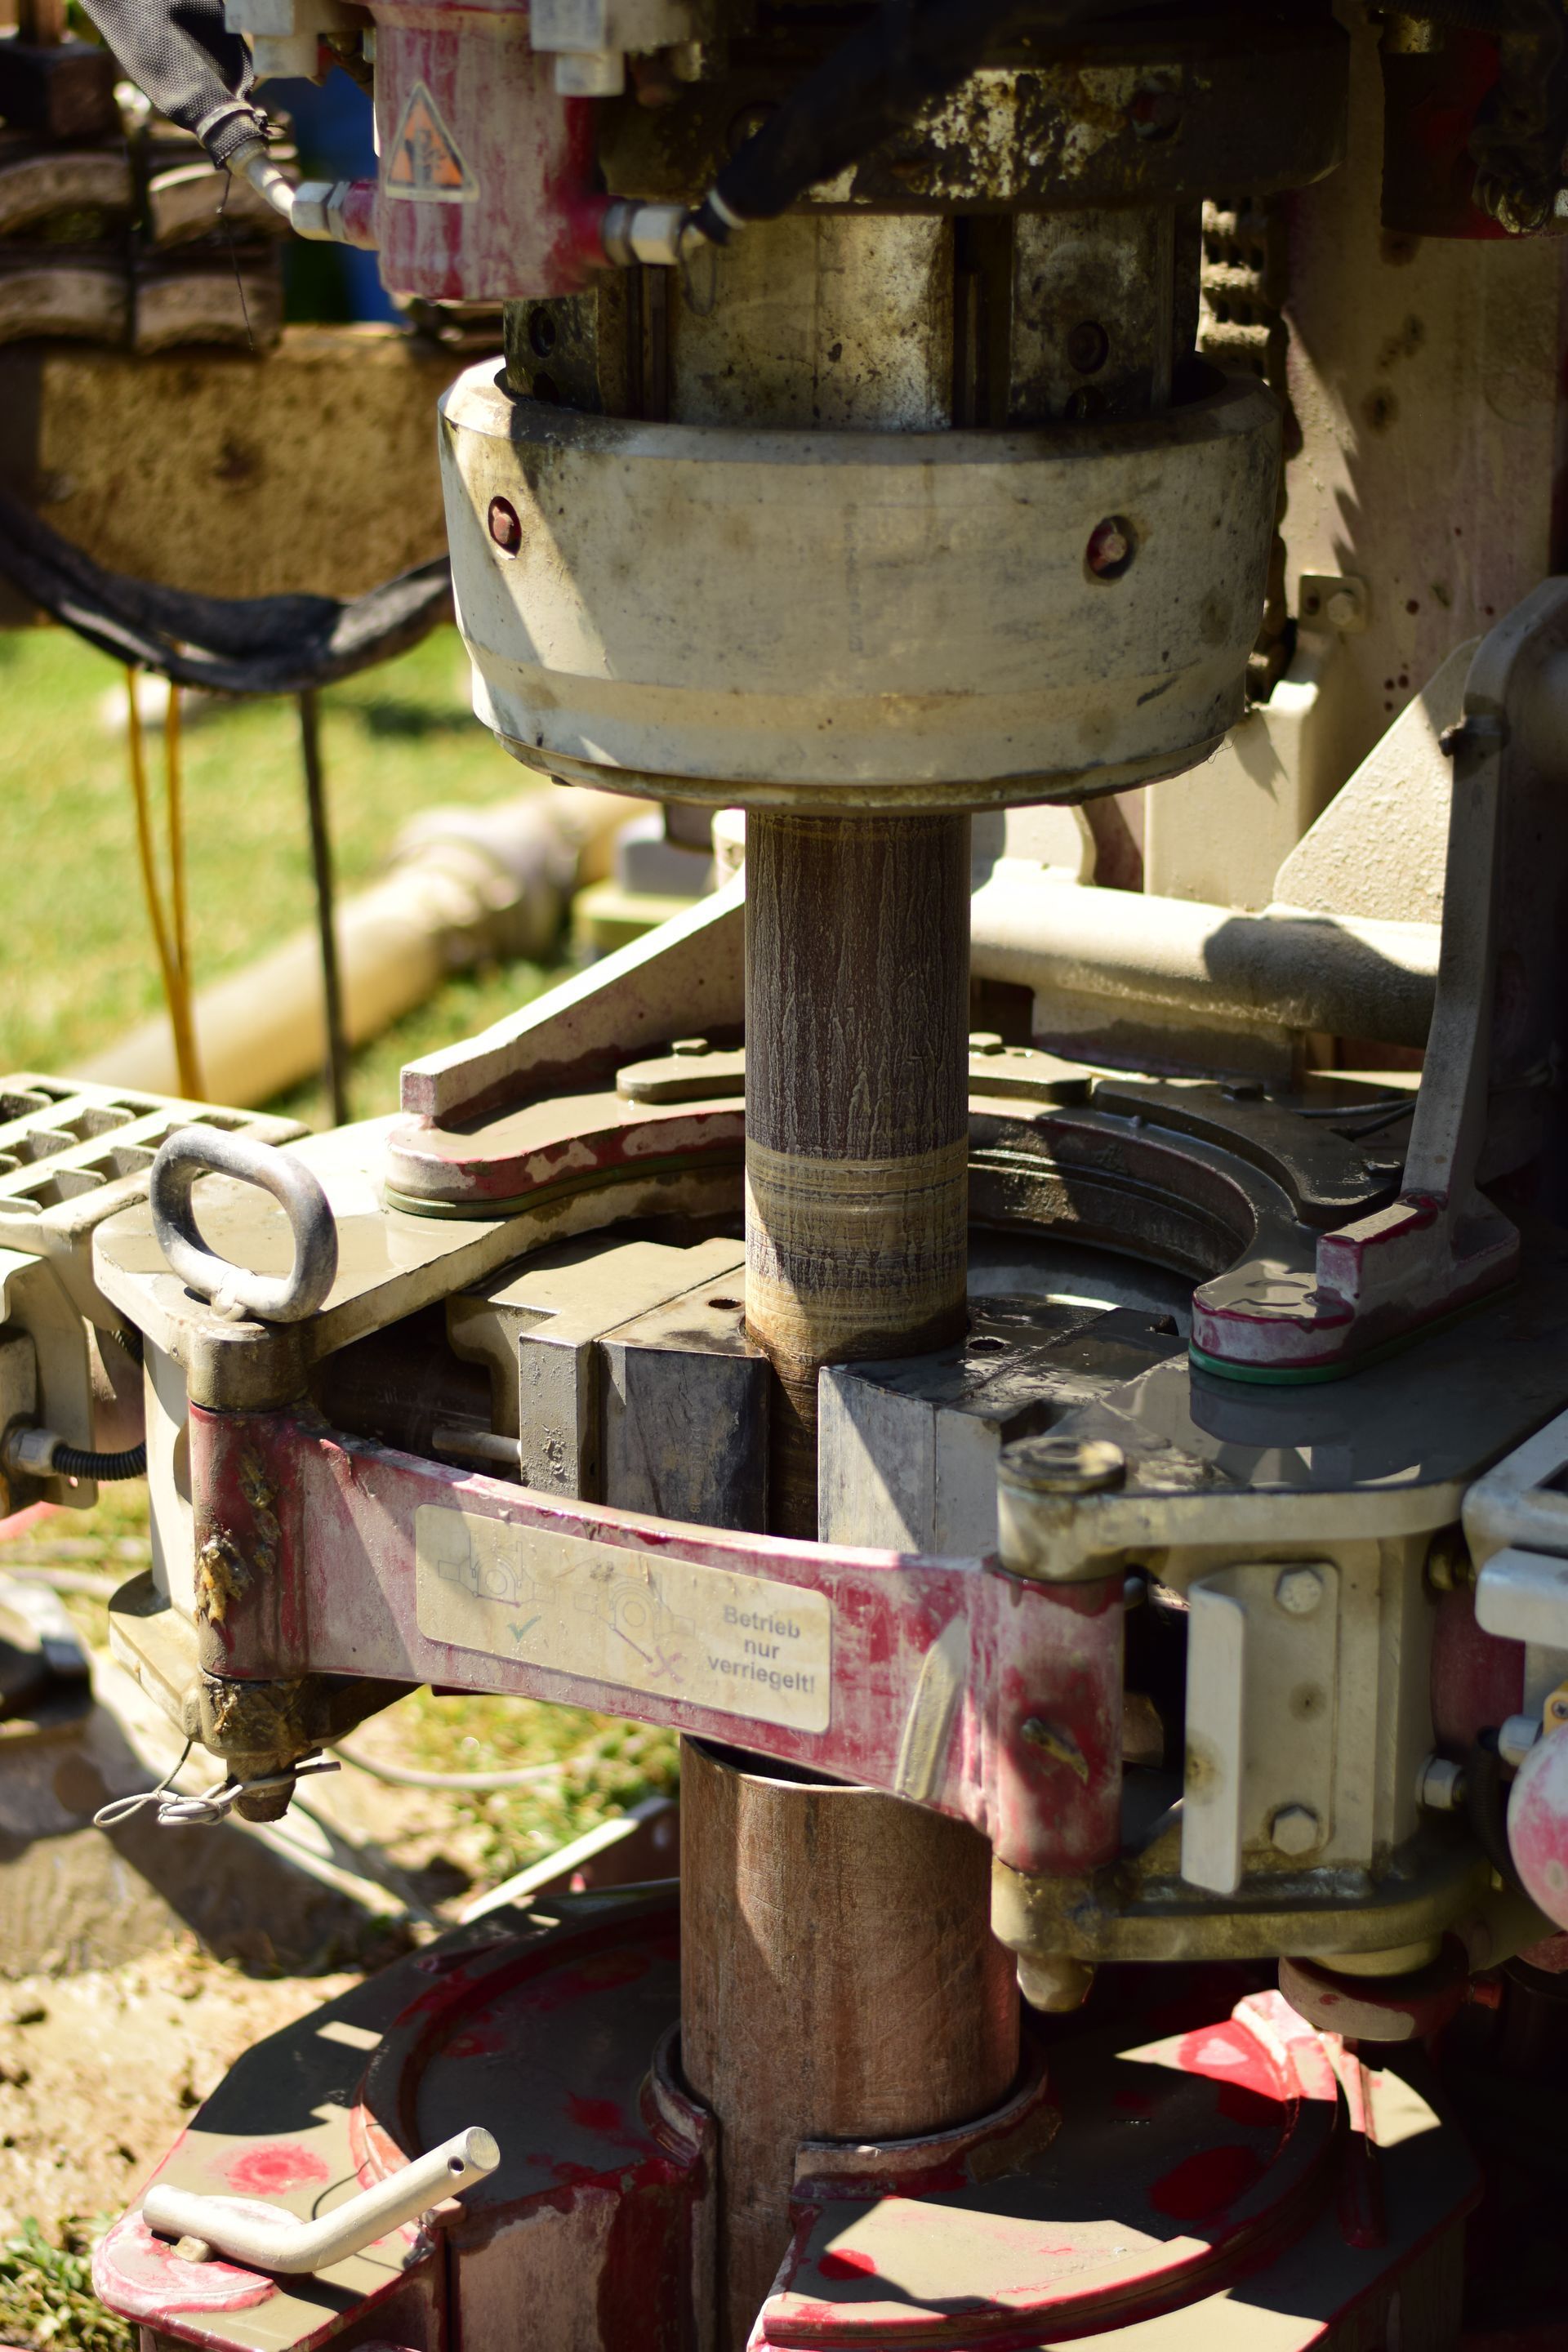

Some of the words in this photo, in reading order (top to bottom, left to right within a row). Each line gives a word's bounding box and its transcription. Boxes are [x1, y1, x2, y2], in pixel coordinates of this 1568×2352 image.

[724, 1606, 800, 1638] Betrieb
[744, 1639, 780, 1659] nur
[708, 1656, 814, 1694] verriegelt!
